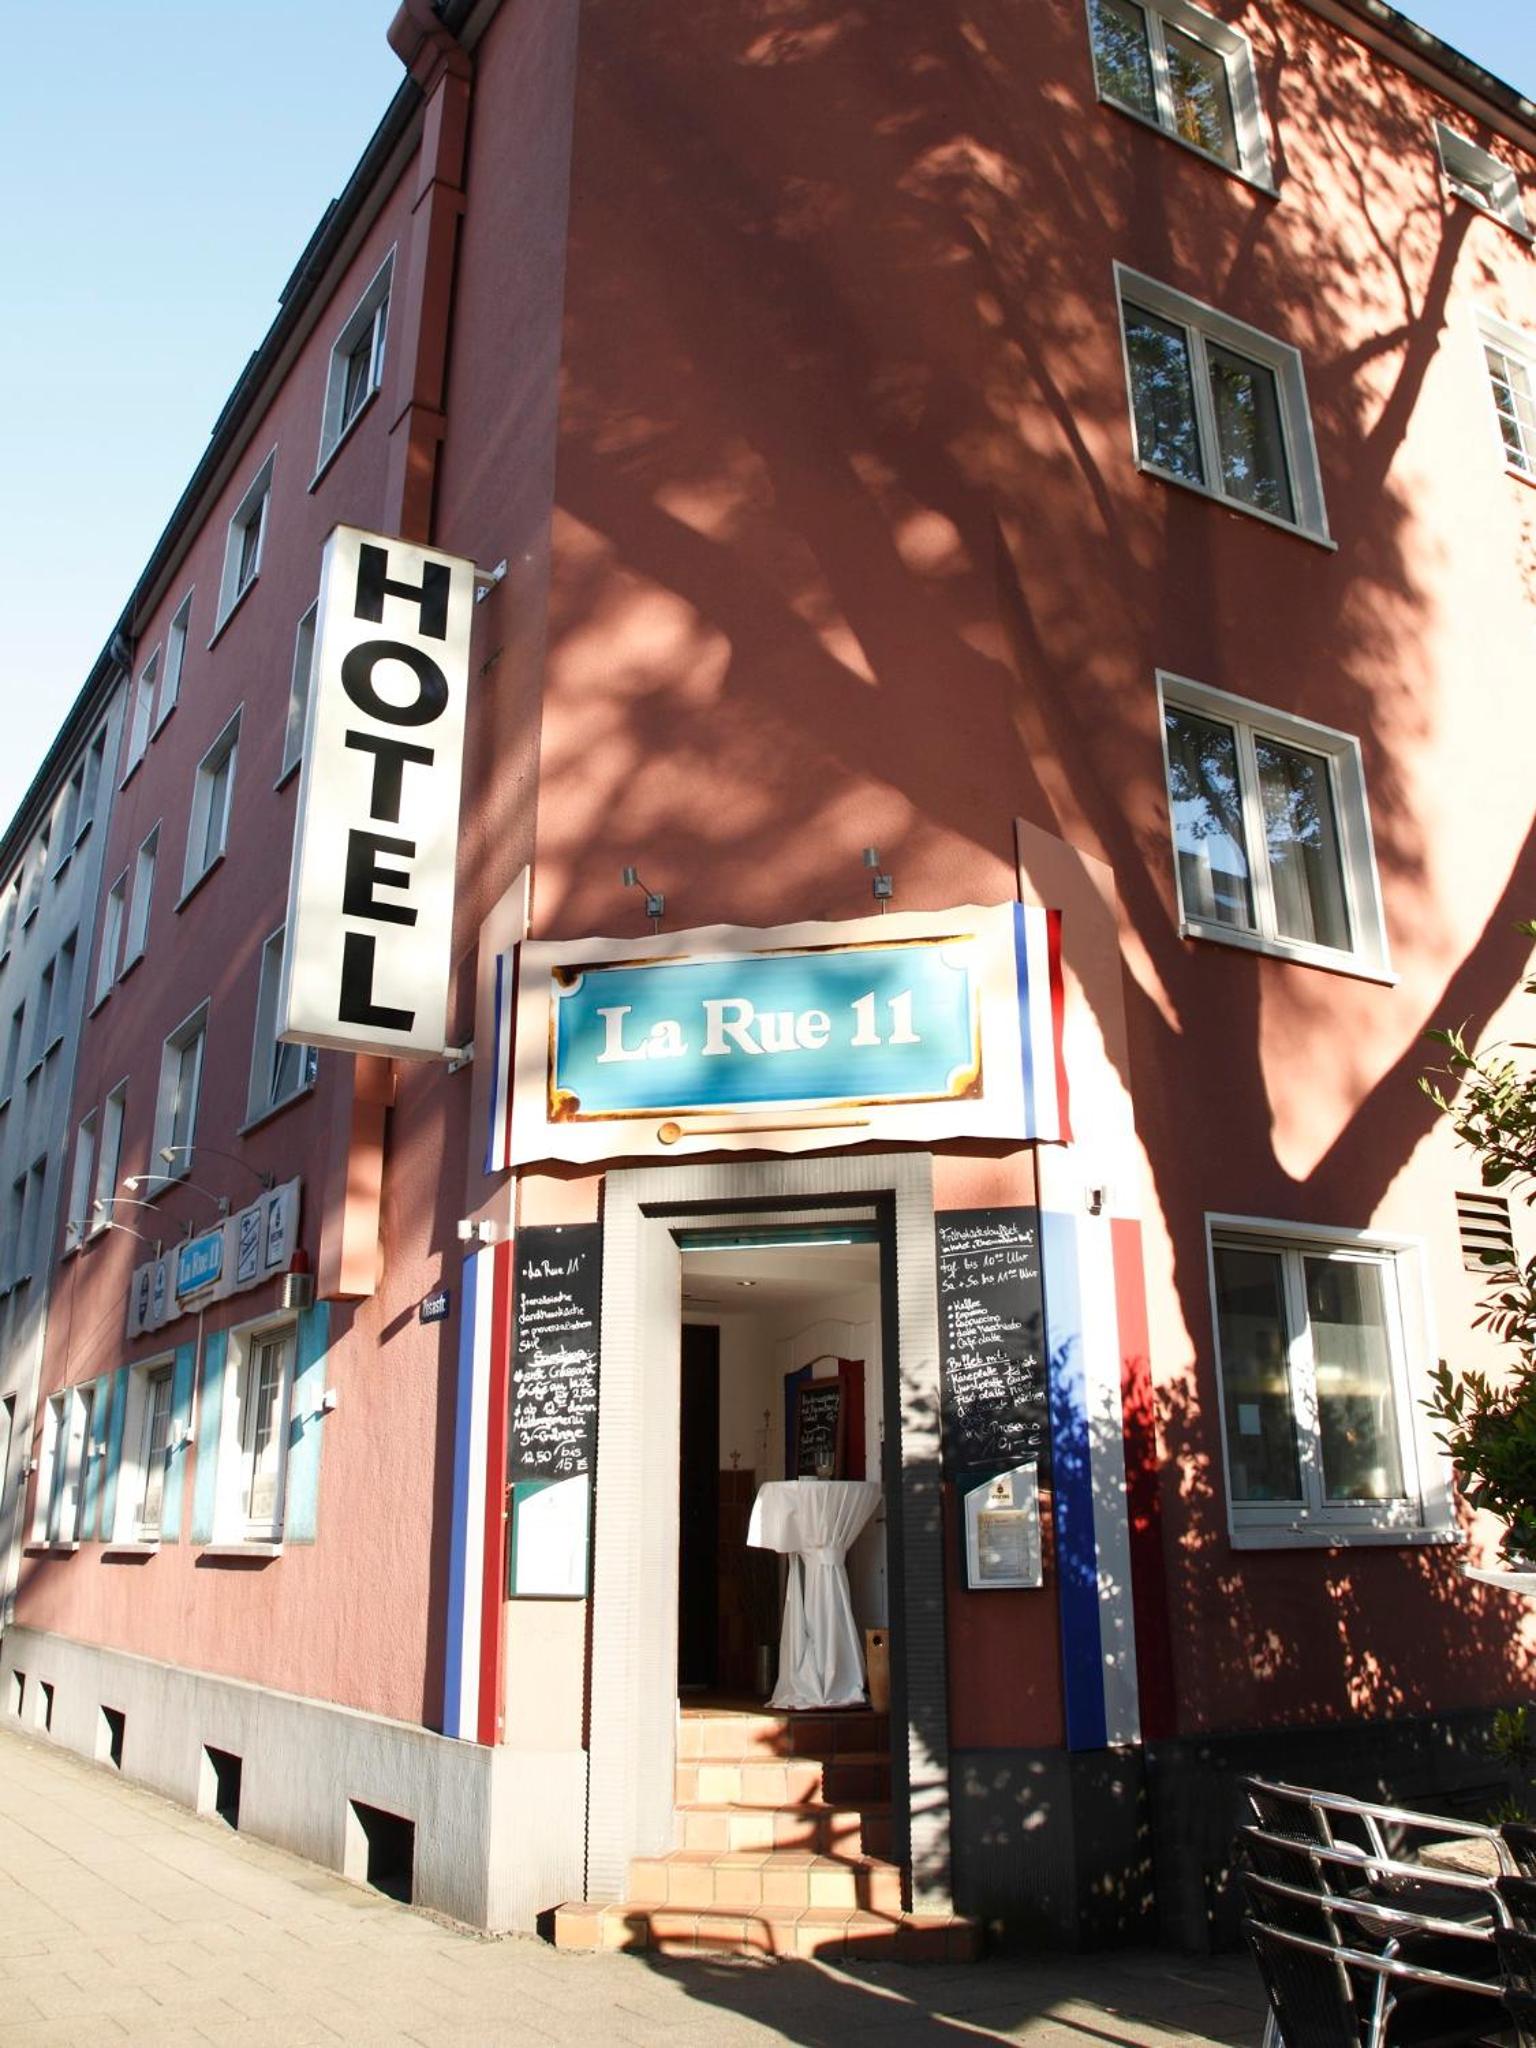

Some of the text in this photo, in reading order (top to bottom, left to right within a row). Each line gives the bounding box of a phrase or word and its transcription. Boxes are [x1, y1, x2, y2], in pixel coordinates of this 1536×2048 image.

[338, 543, 451, 1032] HOTEL
[596, 989, 920, 1063] La Rue 11
[1007, 1251, 1028, 1264] Uhr
[561, 1446, 582, 1457] bis
